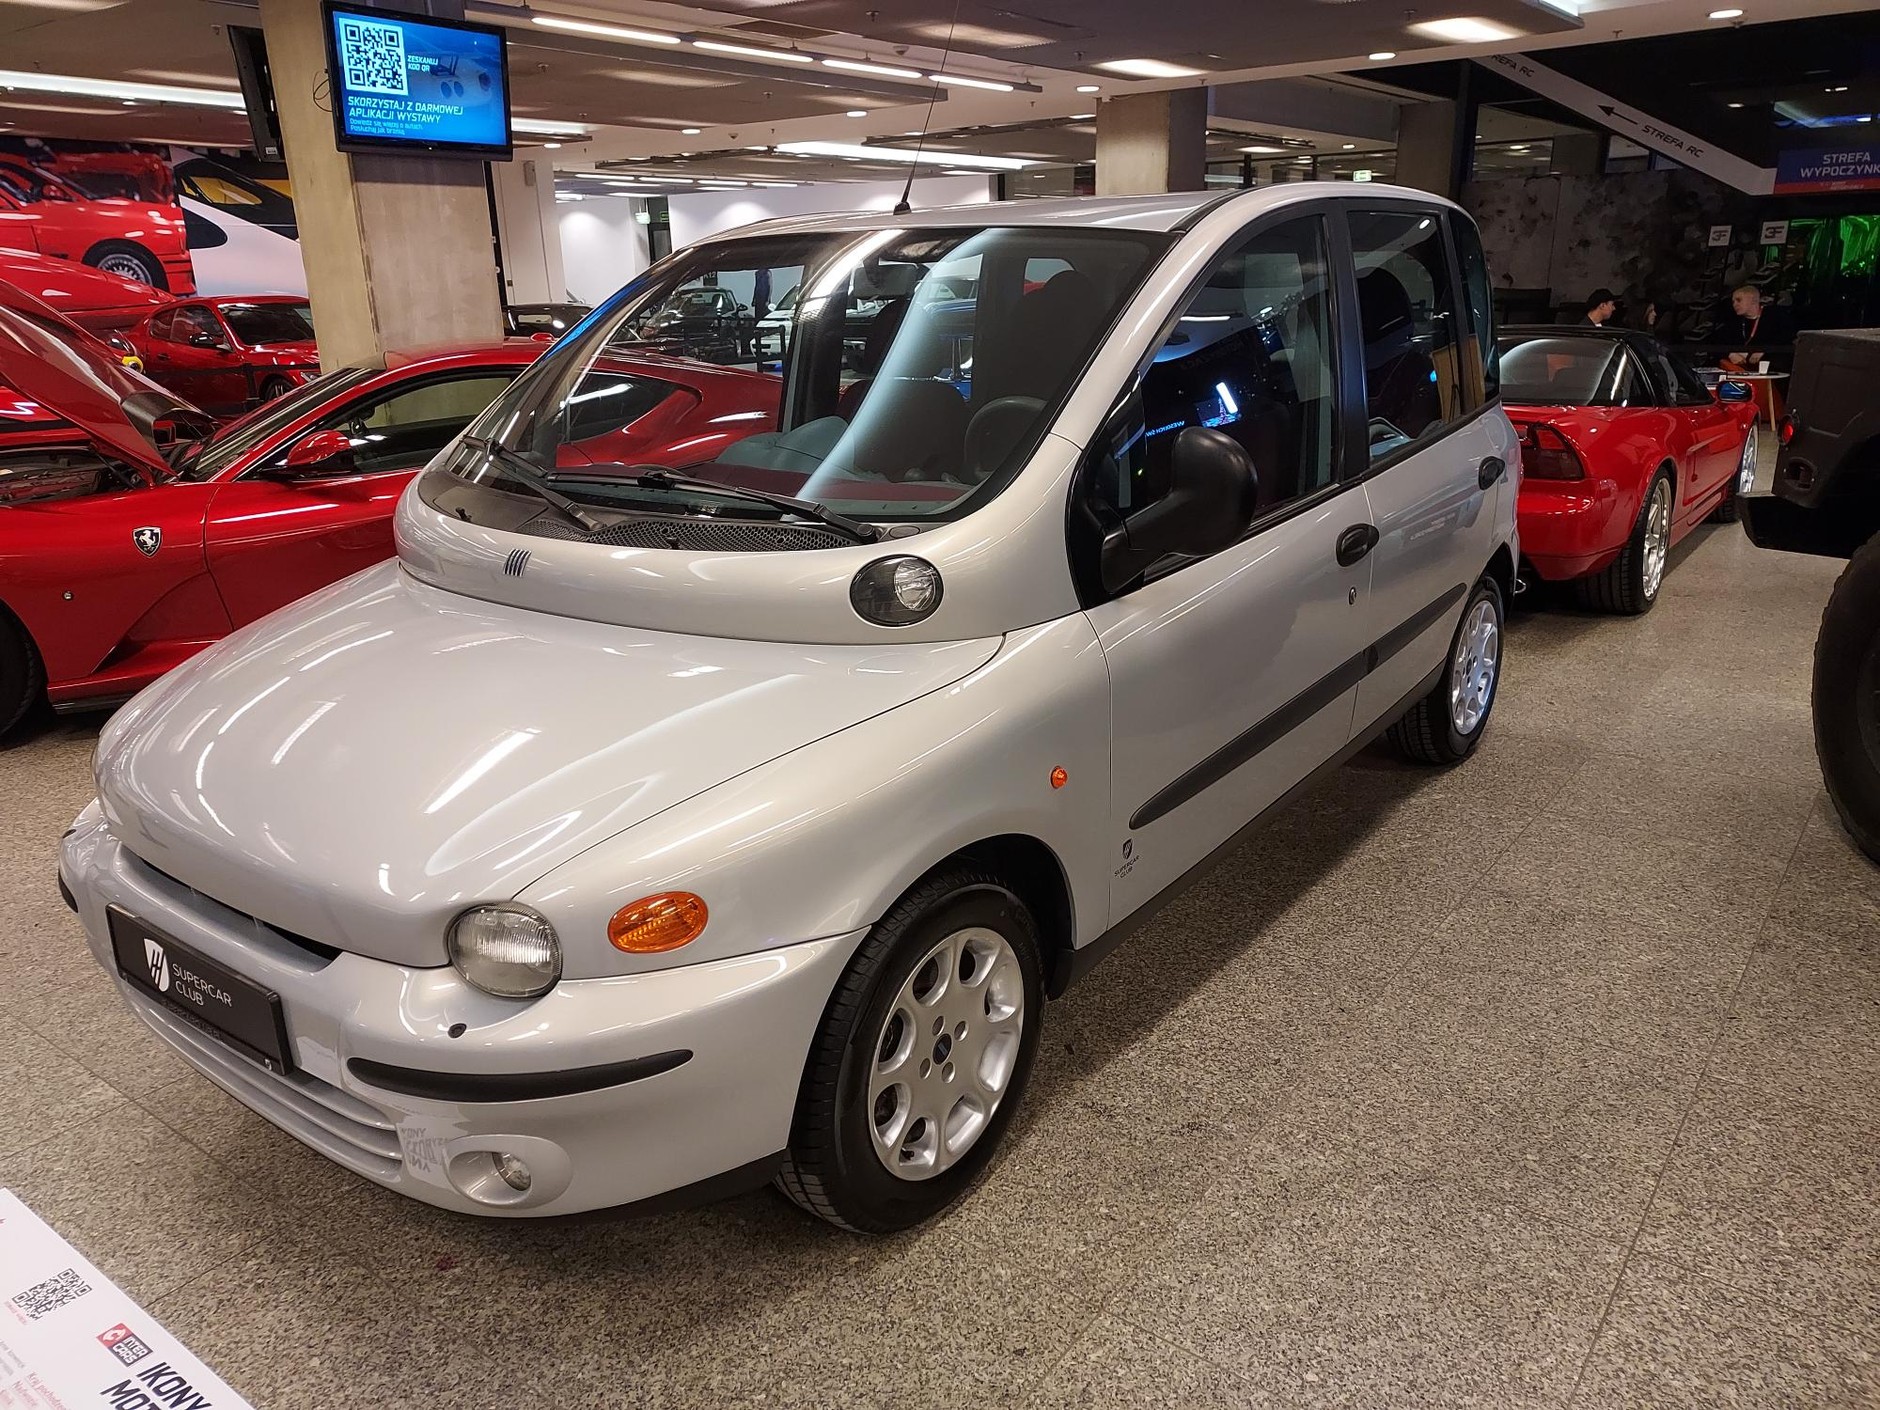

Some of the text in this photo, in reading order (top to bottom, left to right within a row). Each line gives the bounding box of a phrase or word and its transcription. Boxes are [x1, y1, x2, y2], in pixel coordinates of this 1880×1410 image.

[407, 55, 439, 66] ZESKANUJ
[407, 63, 420, 71] KOD
[1519, 65, 1535, 78] RC
[348, 96, 464, 116] SKORZYSTAJ Z DARMOWEJ
[349, 107, 441, 124] APLIKACJI WYSTAWY
[1642, 124, 1704, 158] STREFA RC
[1822, 152, 1871, 165] STREFA
[1800, 164, 1880, 178] WYPOCZYNK
[173, 963, 232, 1007] SUPERCAR
[175, 981, 204, 1006] CLUB
[112, 1341, 138, 1365] CARS
[123, 1335, 149, 1358] INTER
[136, 1361, 212, 1410] IKONY
